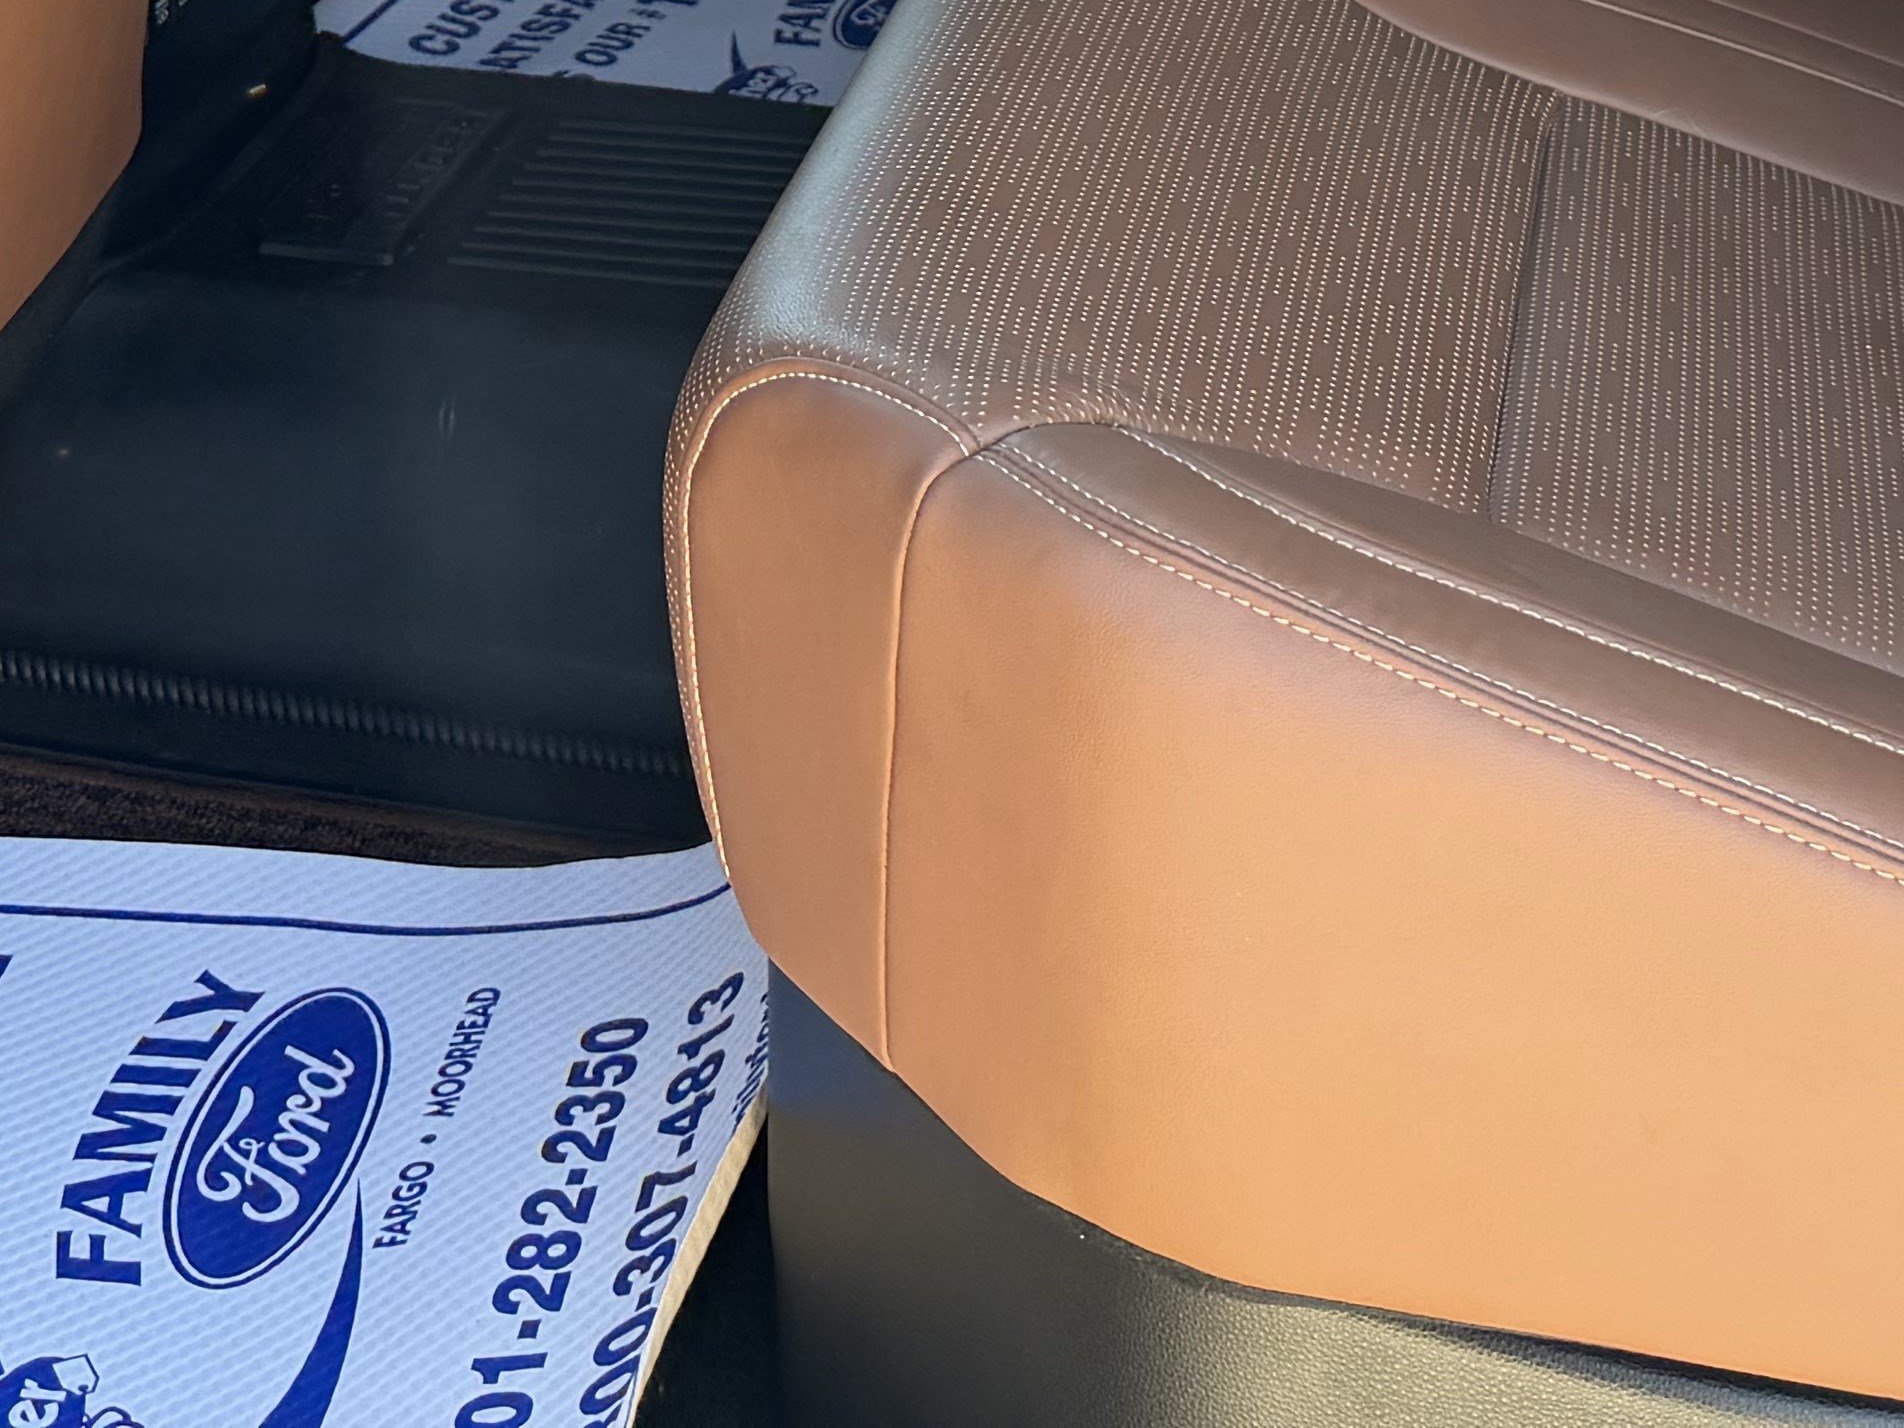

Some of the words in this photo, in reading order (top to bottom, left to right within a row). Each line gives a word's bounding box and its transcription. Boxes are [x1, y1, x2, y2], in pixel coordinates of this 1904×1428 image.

[574, 22, 651, 66] OUR
[55, 969, 266, 1287] FAMILY
[196, 1044, 356, 1223] Ford
[371, 1161, 435, 1249] FARGO
[423, 987, 501, 1118] MOORHEAD
[454, 1016, 650, 1428] 01-282-2350
